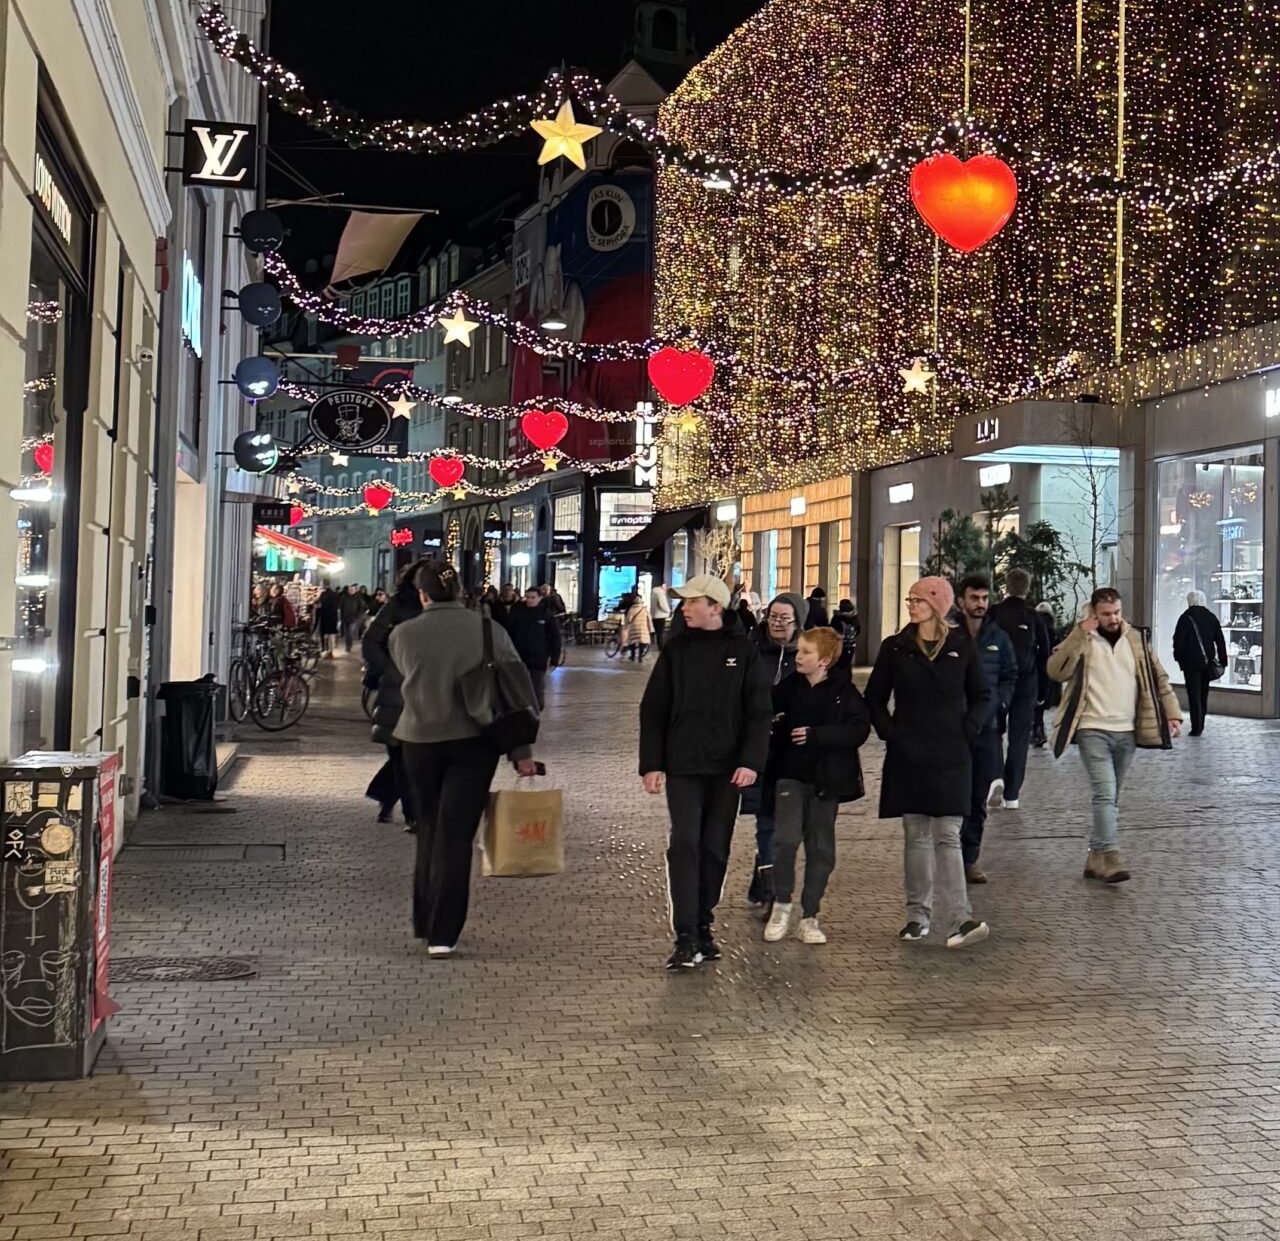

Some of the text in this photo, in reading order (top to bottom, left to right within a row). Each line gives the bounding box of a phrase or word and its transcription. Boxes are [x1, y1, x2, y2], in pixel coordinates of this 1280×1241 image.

[190, 126, 249, 182] LV
[327, 394, 376, 409] PETITGAS
[611, 516, 652, 527] synoptik
